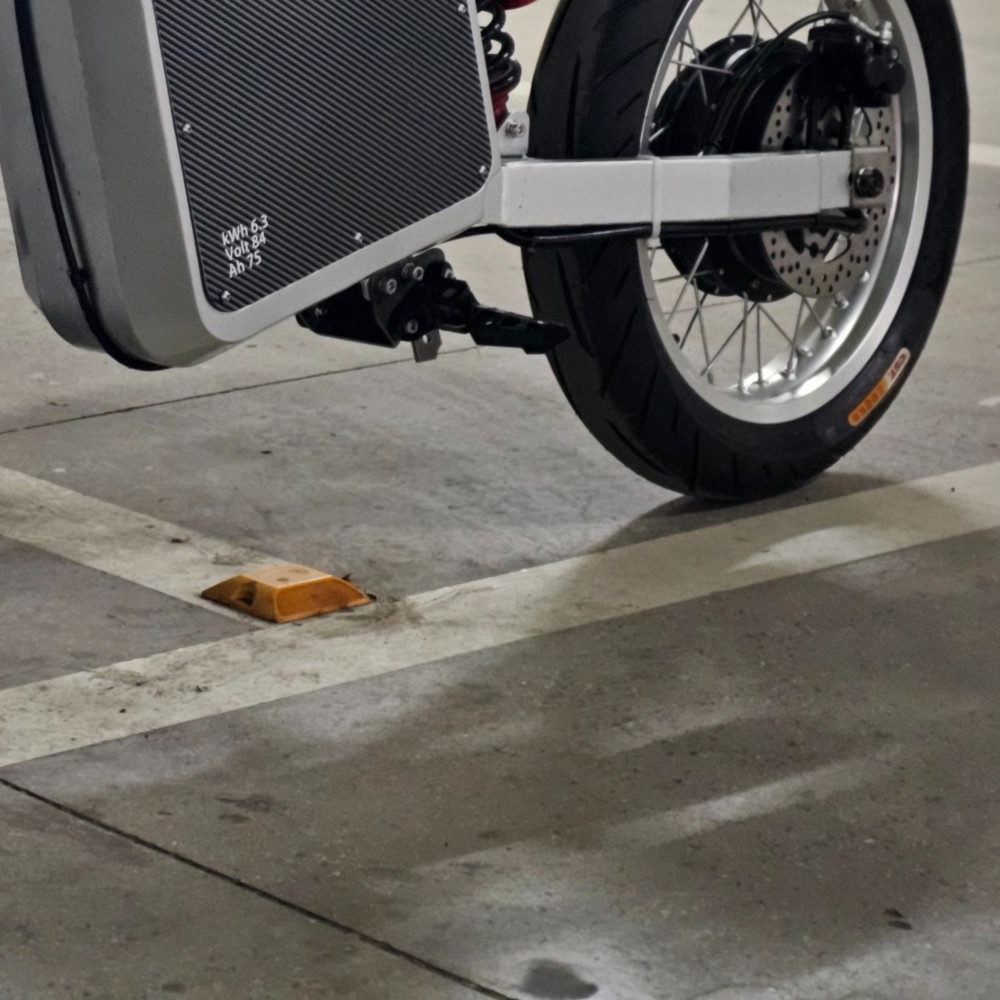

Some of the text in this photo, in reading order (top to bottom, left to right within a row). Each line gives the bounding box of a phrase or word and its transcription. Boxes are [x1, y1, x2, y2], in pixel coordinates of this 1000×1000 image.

[222, 214, 269, 247] kWh 6.3
[225, 231, 267, 261] Volt 84
[229, 249, 262, 278] Ah 75
